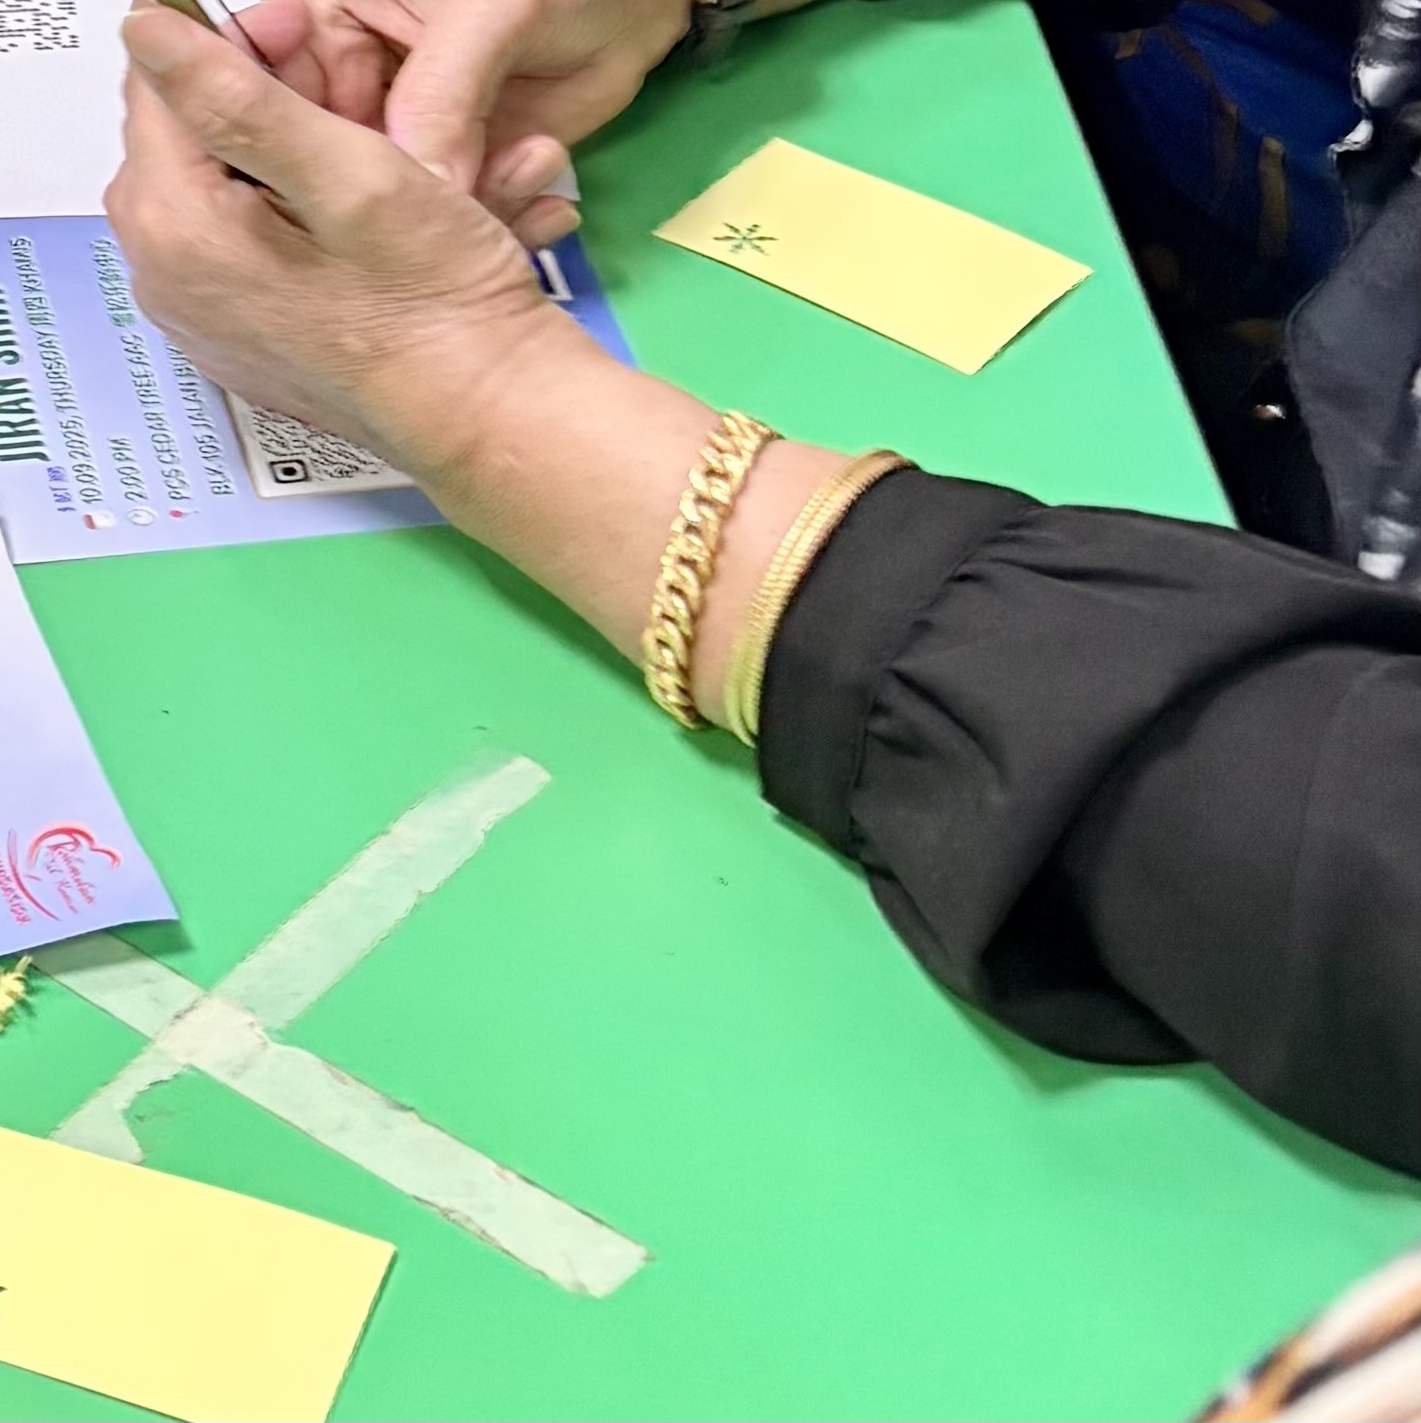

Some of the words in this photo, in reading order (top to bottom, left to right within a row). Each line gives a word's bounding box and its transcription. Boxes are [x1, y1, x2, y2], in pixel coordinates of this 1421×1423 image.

[31, 328, 80, 414] THURSDAY
[130, 370, 163, 411] TREE
[143, 410, 179, 467] CEDAR
[194, 434, 223, 463] 105
[165, 467, 193, 502] PCS
